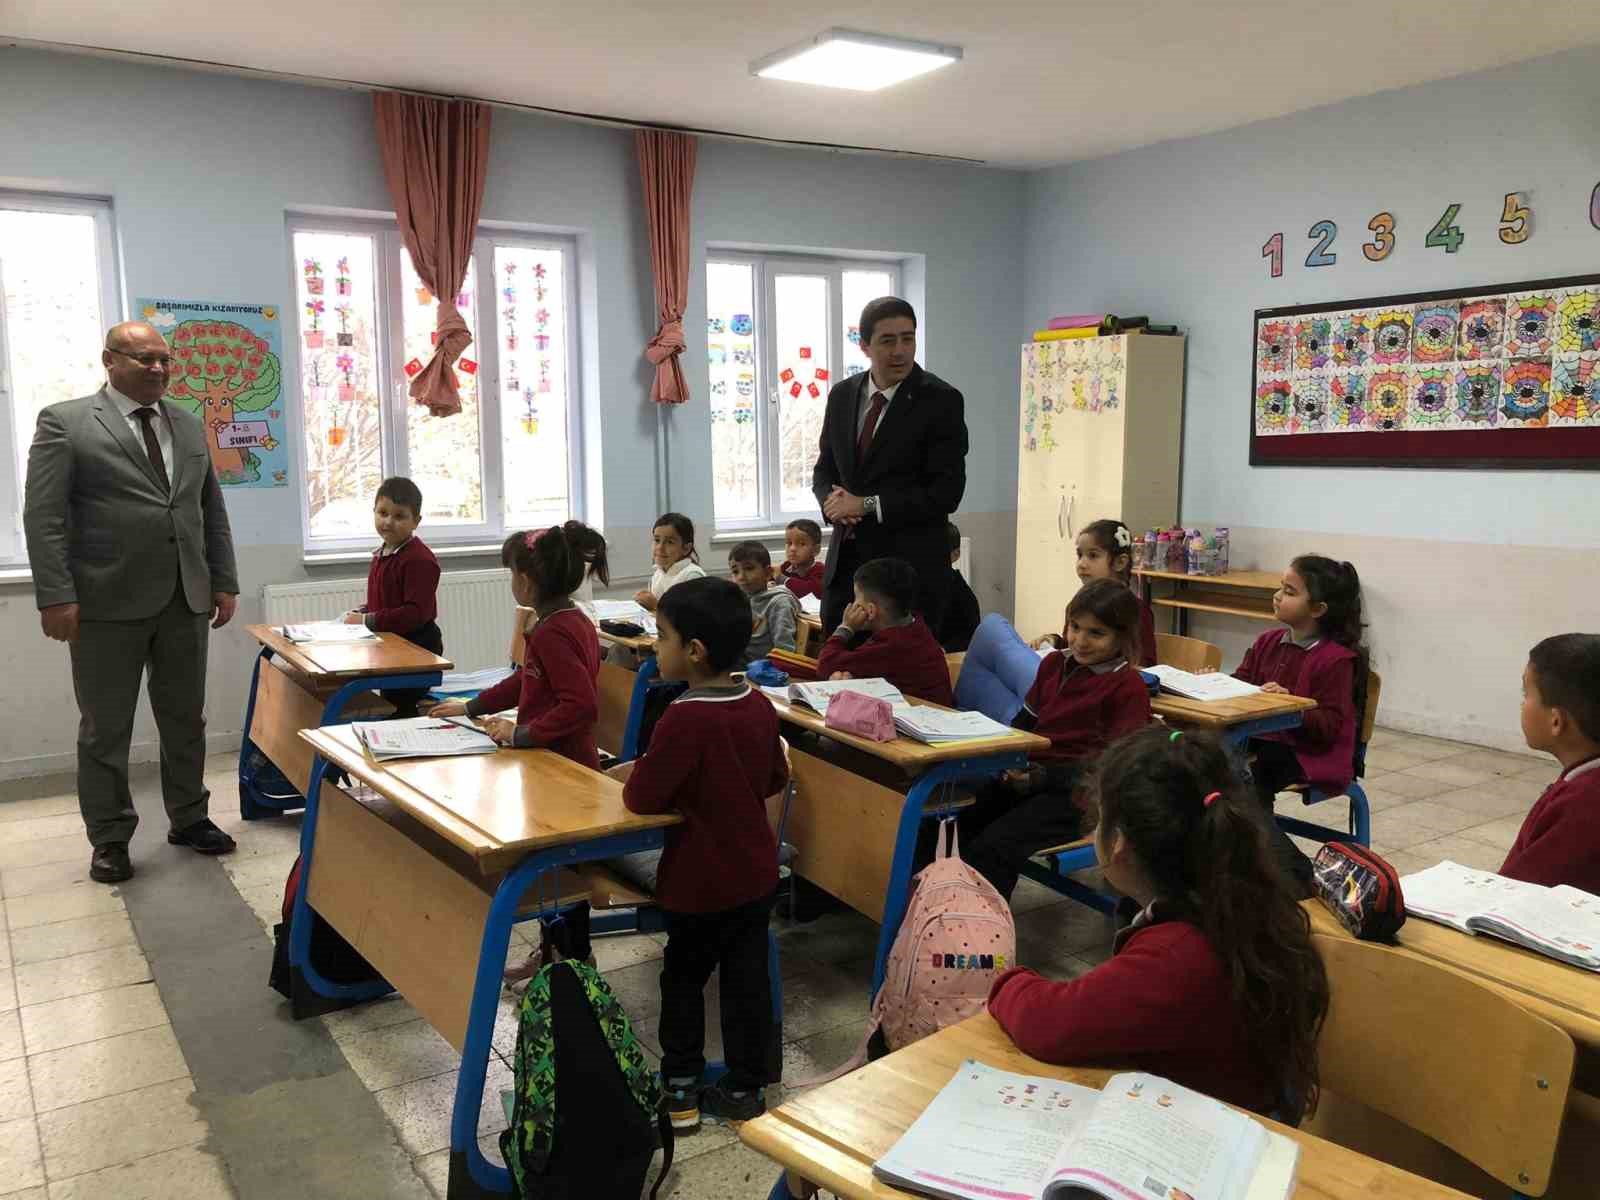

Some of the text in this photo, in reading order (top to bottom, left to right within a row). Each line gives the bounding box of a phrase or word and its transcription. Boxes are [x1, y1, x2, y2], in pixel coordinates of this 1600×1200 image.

[1262, 232, 1284, 278] 1
[1304, 219, 1337, 267] 2
[1362, 211, 1396, 262] 3
[1425, 203, 1465, 253] 4
[1498, 191, 1531, 244] 5
